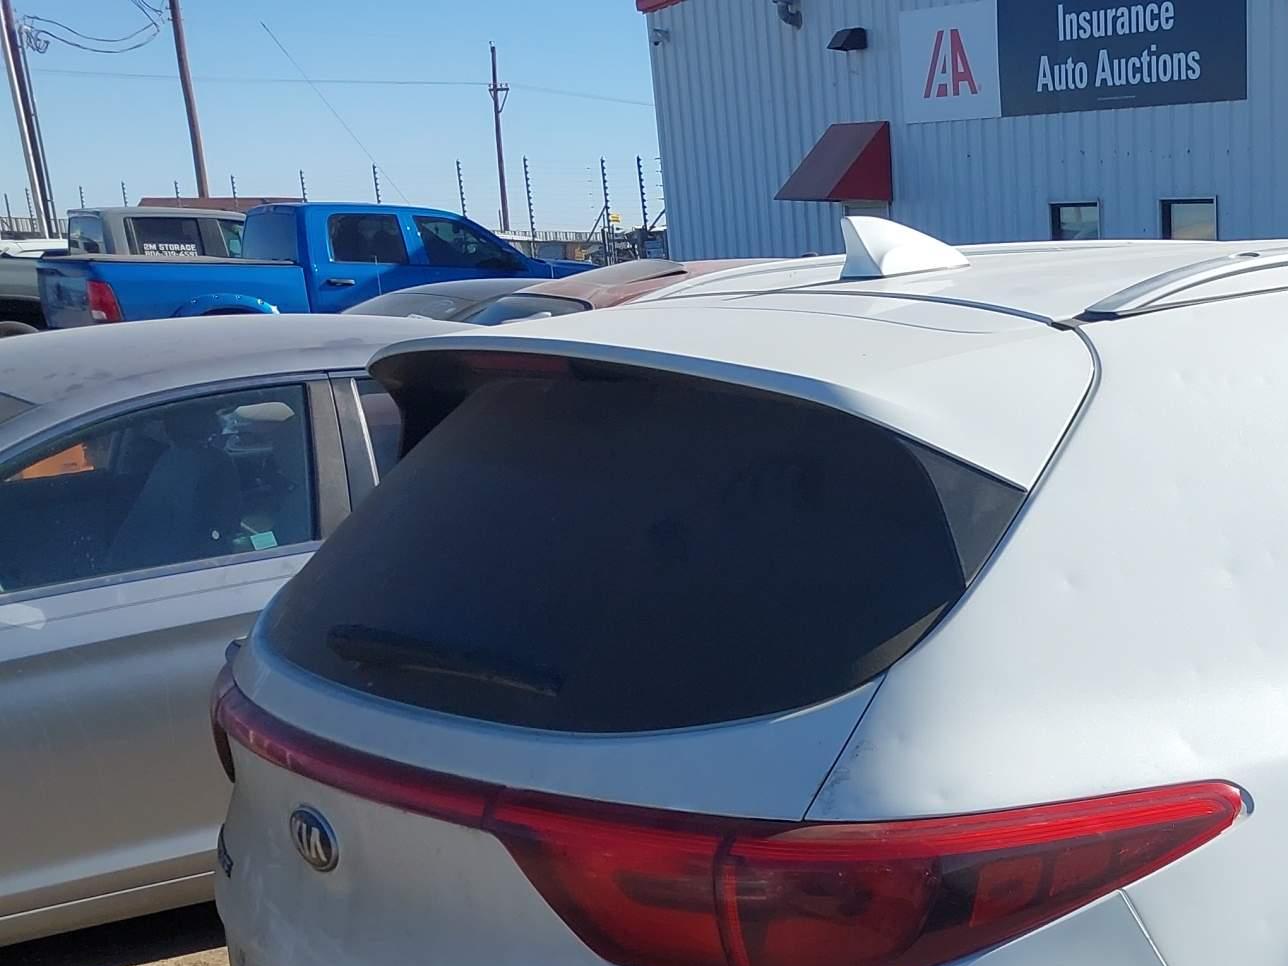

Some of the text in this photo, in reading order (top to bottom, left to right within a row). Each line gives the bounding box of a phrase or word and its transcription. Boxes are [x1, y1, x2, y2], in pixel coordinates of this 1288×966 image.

[1057, 1, 1174, 41] Insurance
[1036, 44, 1201, 92] Auto Auctions
[292, 815, 328, 863] KIA
